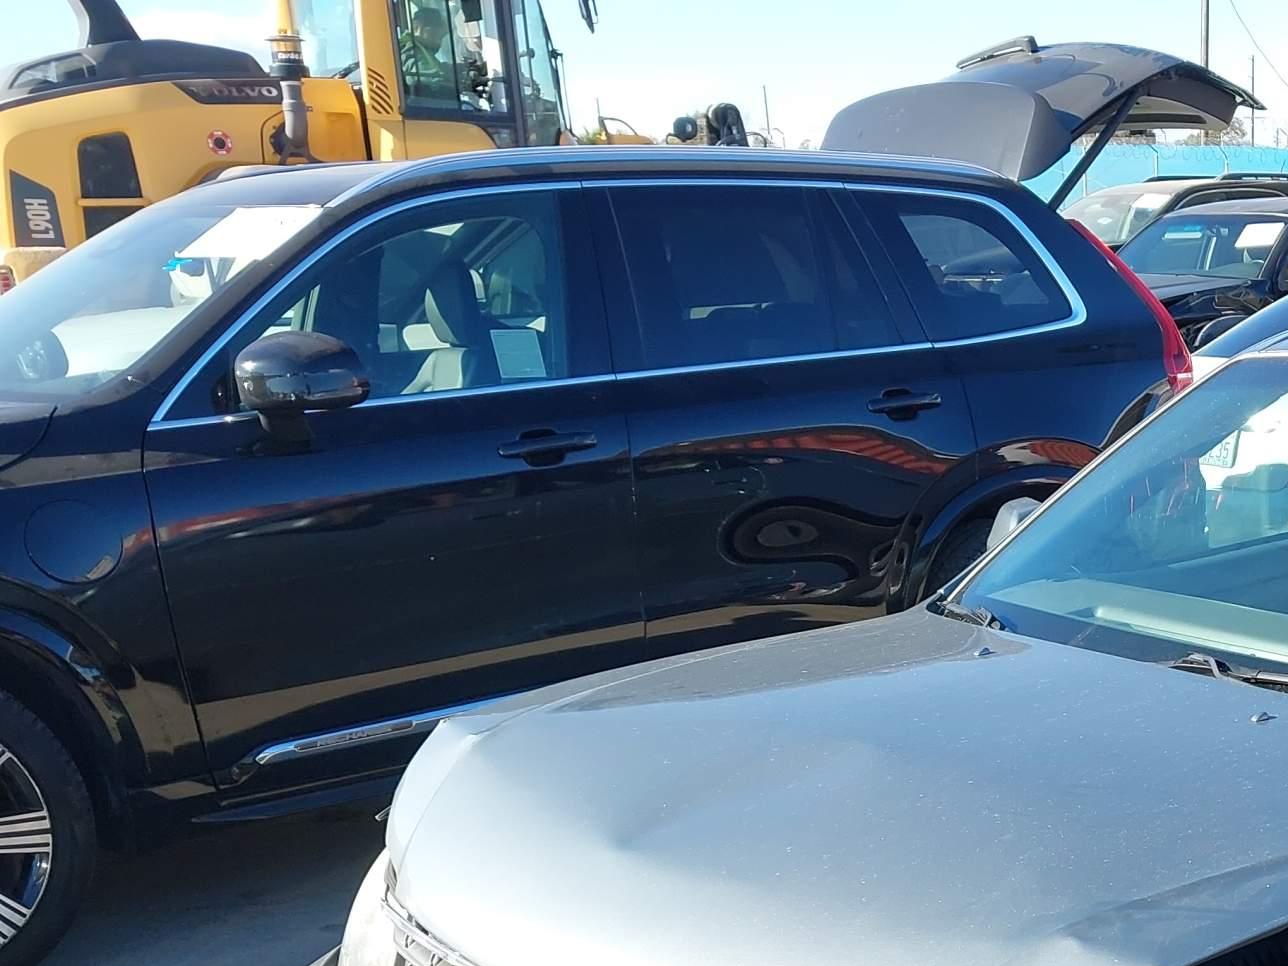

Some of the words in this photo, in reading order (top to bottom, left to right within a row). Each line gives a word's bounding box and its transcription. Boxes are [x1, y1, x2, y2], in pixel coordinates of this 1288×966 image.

[189, 86, 279, 97] VOLVO
[23, 198, 55, 239] L90H
[316, 728, 392, 747] RECHA
